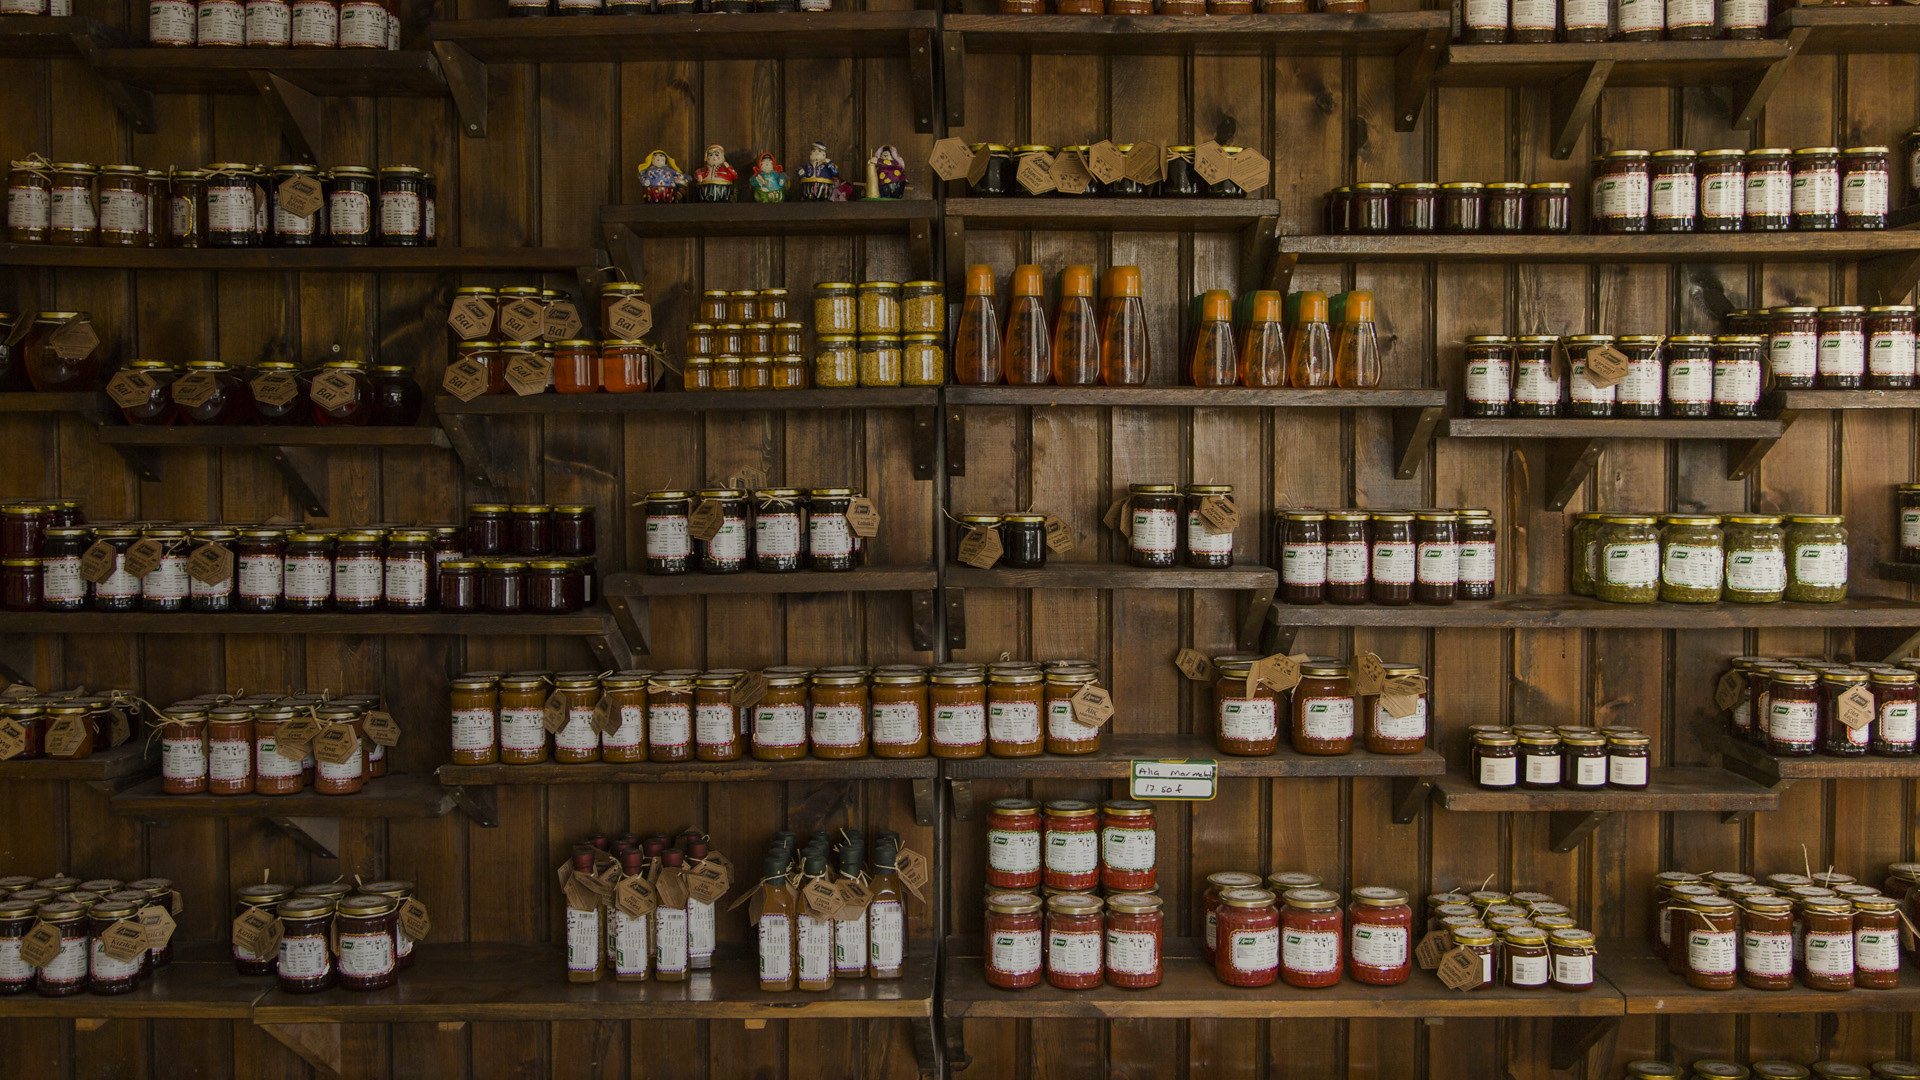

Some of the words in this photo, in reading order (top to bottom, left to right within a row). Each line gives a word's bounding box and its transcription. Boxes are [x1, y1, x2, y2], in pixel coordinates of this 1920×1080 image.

[455, 313, 474, 330] Bal
[505, 318, 525, 332] Bal
[616, 317, 636, 332] Bal
[548, 326, 566, 337] Bal
[512, 365, 530, 378] Bal
[113, 382, 131, 396] Bal
[448, 376, 468, 390] Bal
[316, 388, 336, 402] Bal
